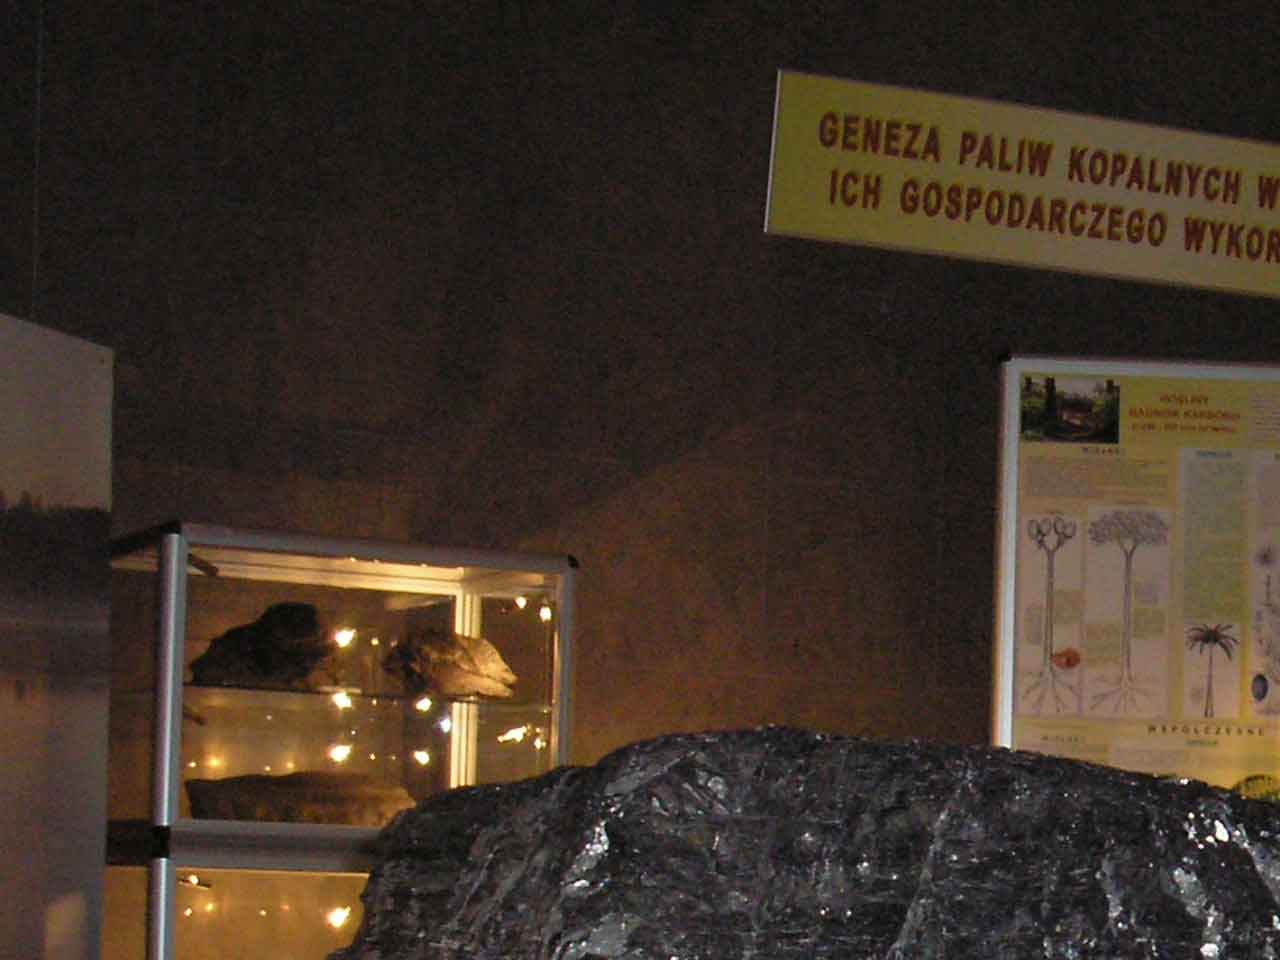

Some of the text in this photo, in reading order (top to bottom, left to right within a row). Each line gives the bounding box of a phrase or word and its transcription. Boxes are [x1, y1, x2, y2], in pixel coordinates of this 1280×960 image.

[818, 111, 941, 163] GENEZA
[958, 131, 1054, 177] PALIW
[1067, 146, 1242, 205] KOPALNYCH
[1257, 175, 1280, 211] W
[829, 168, 881, 209] ICH
[900, 178, 1168, 247] GOSPODARCZEGO
